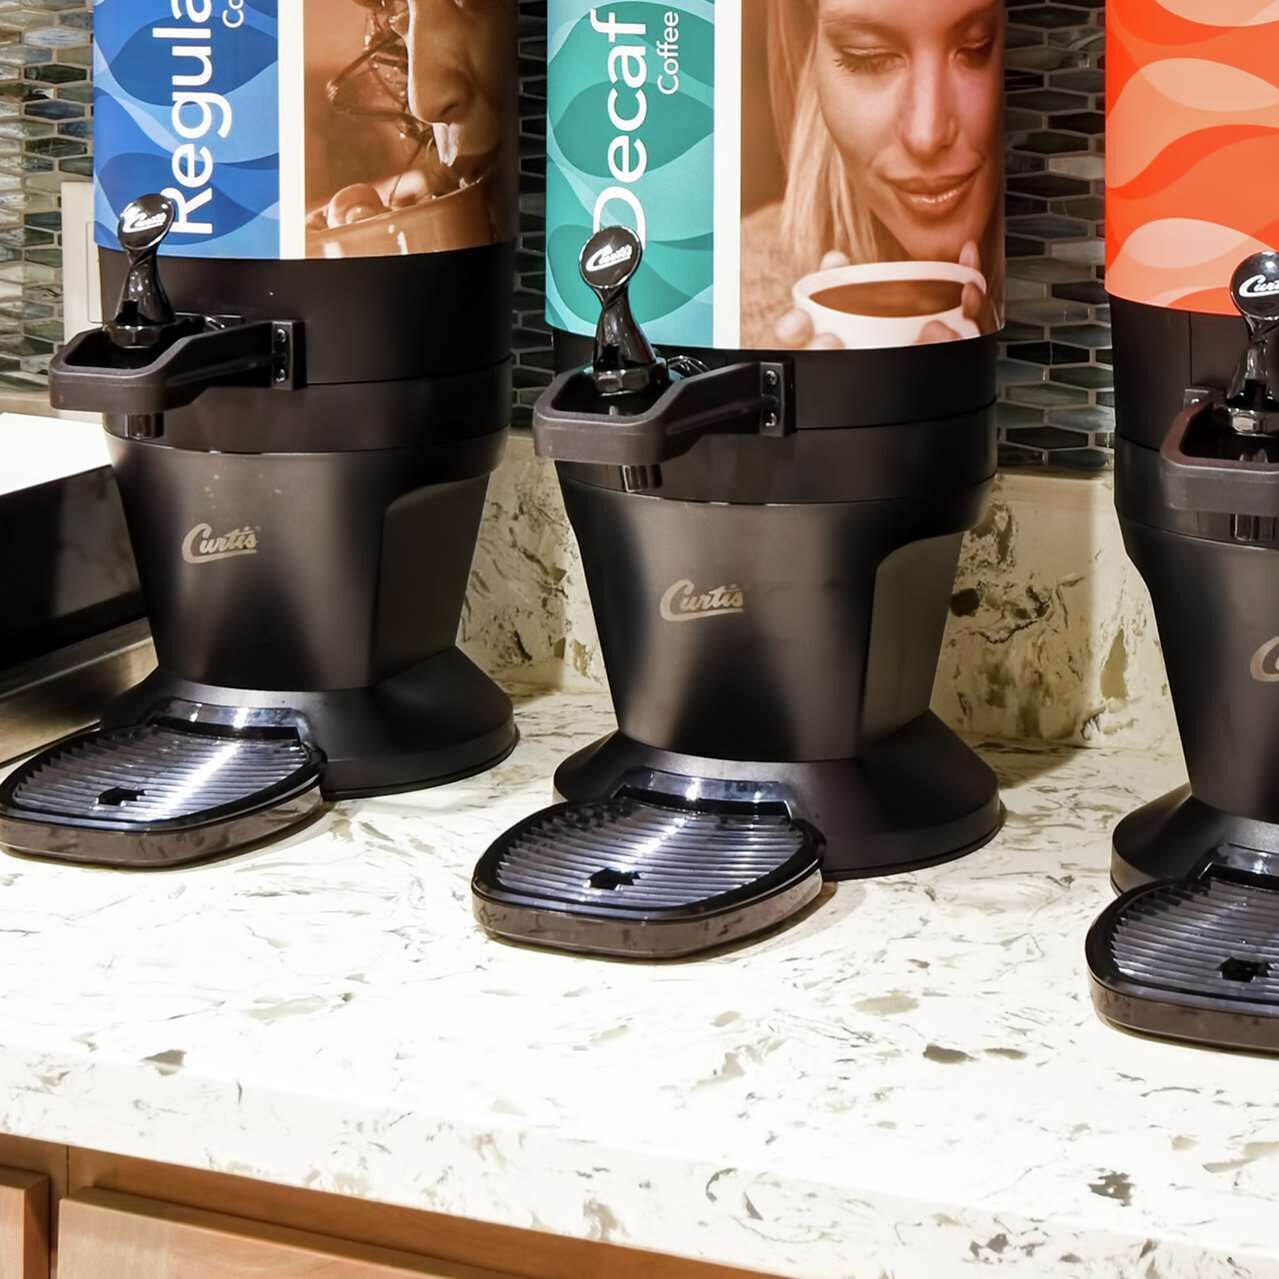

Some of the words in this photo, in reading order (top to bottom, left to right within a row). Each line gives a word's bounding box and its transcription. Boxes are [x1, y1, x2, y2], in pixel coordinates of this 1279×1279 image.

[657, 10, 680, 95] Coffee
[182, 523, 257, 564] Curtis
[660, 579, 744, 622] Curtis
